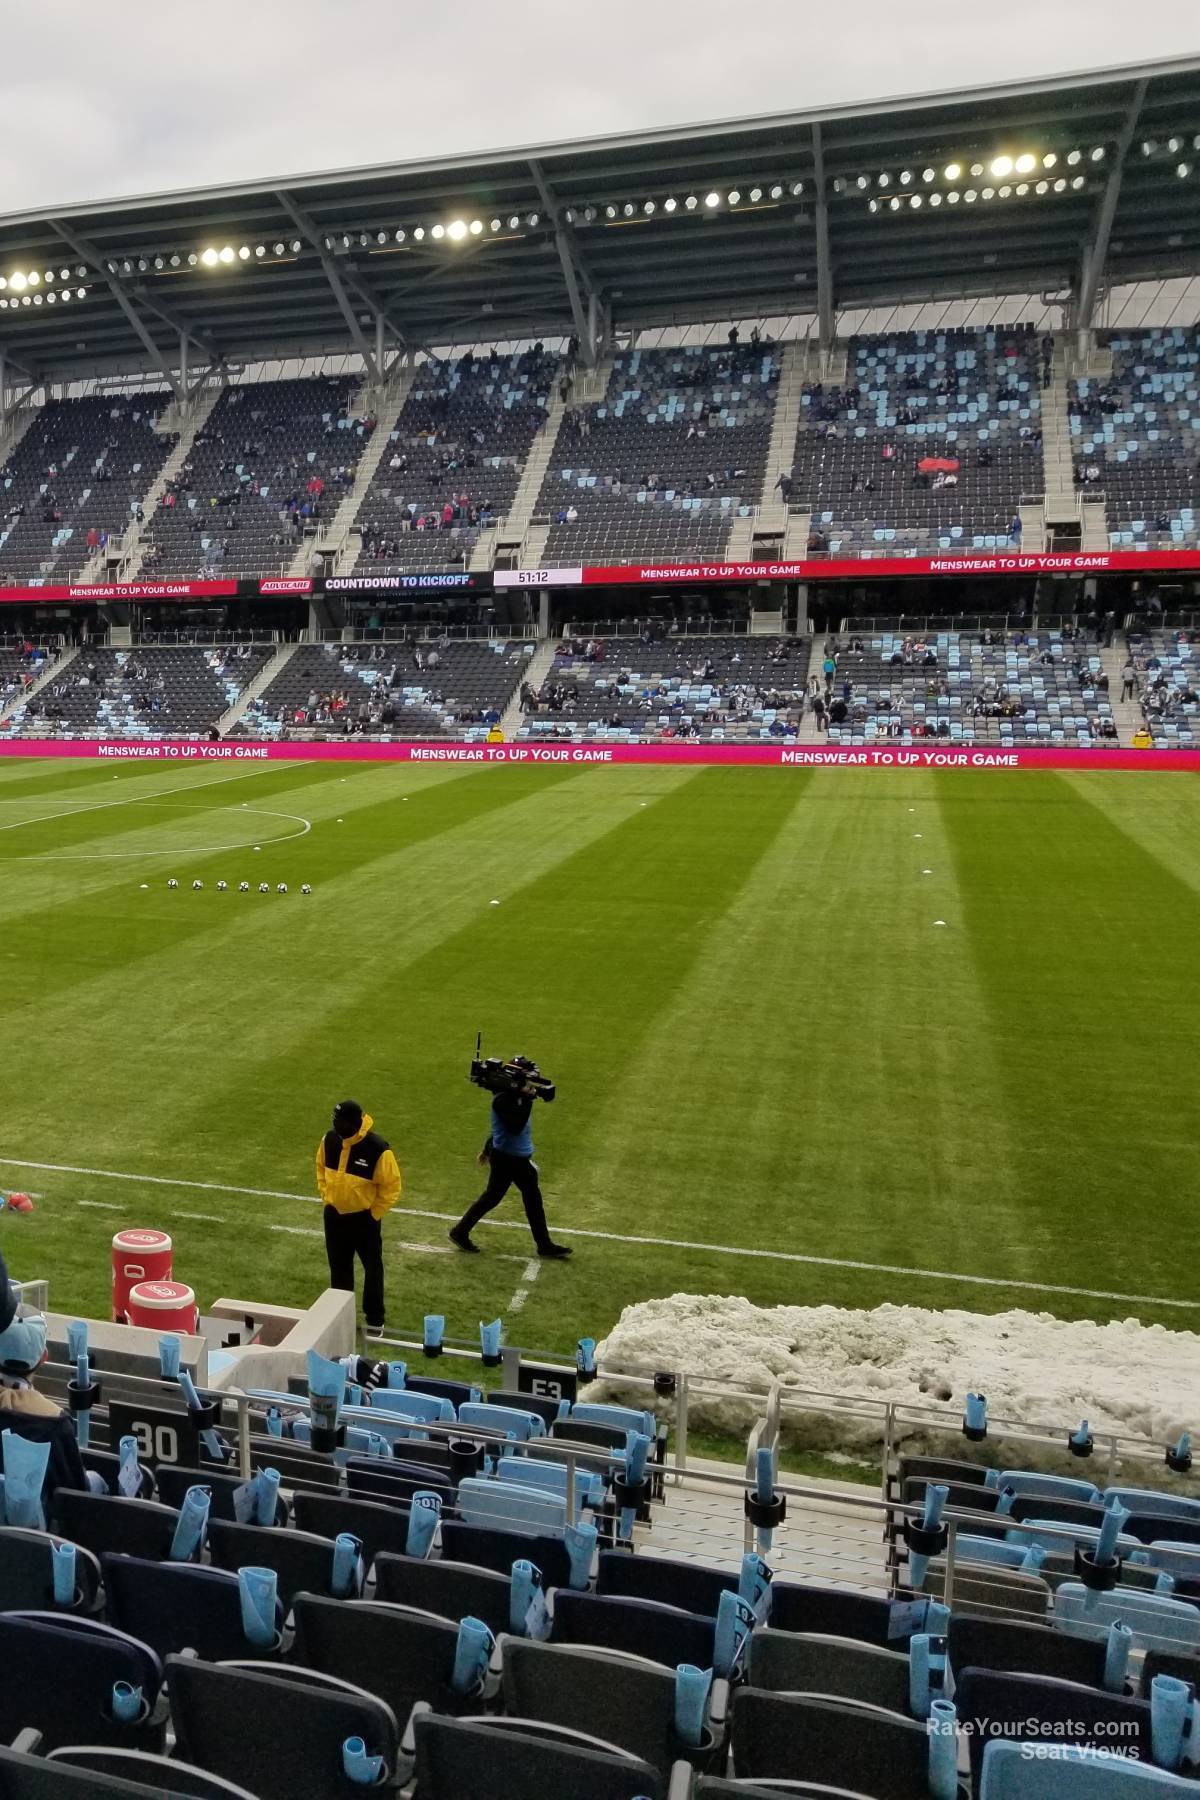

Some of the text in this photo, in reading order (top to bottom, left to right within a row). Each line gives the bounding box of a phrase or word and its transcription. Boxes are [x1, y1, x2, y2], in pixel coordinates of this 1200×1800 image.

[930, 557, 1109, 570] MENSWEAR TO UP YOUR GAME
[519, 572, 548, 582] 51:12
[641, 565, 800, 578] MENSWEAR TO UP YOUR GAME
[262, 581, 310, 590] ADVOCARE
[326, 578, 399, 589] COUNTDOWN
[401, 577, 417, 587] TO
[70, 588, 114, 596] MENSWEAR
[116, 587, 127, 595] TO
[129, 586, 140, 594] UP
[142, 586, 164, 594] YOUR
[98, 746, 268, 757] MENSWEAR TO UP YOUR GAME
[410, 749, 612, 761] MENSWEAR TO UP YOUR GAME
[782, 752, 1018, 766] MENSWEAR TO UP YOUR GAME
[533, 1379, 561, 1399] E3
[132, 1421, 178, 1463] 30
